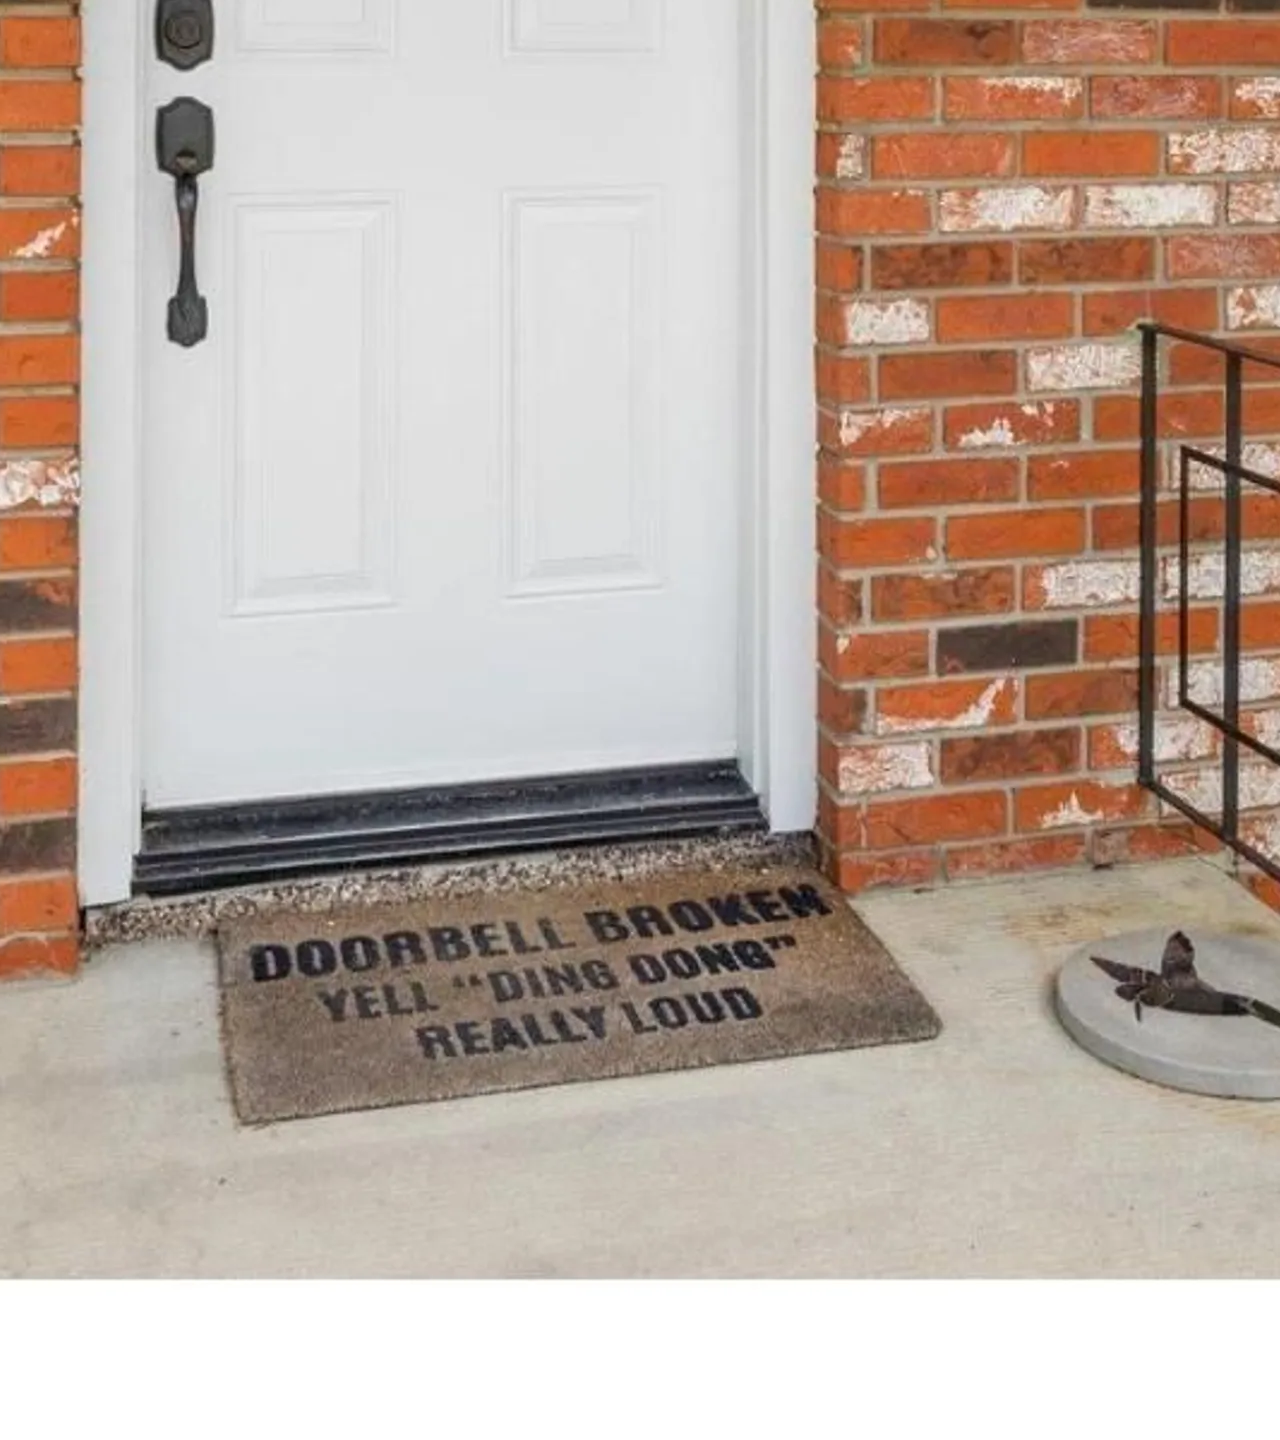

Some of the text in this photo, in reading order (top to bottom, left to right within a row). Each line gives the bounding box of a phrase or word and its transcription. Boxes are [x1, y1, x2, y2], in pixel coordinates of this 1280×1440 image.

[249, 881, 834, 983] DOORBELL BROKEN
[320, 933, 798, 1024] YELL “DING DONG”
[415, 986, 764, 1061] REALLY LOUD
